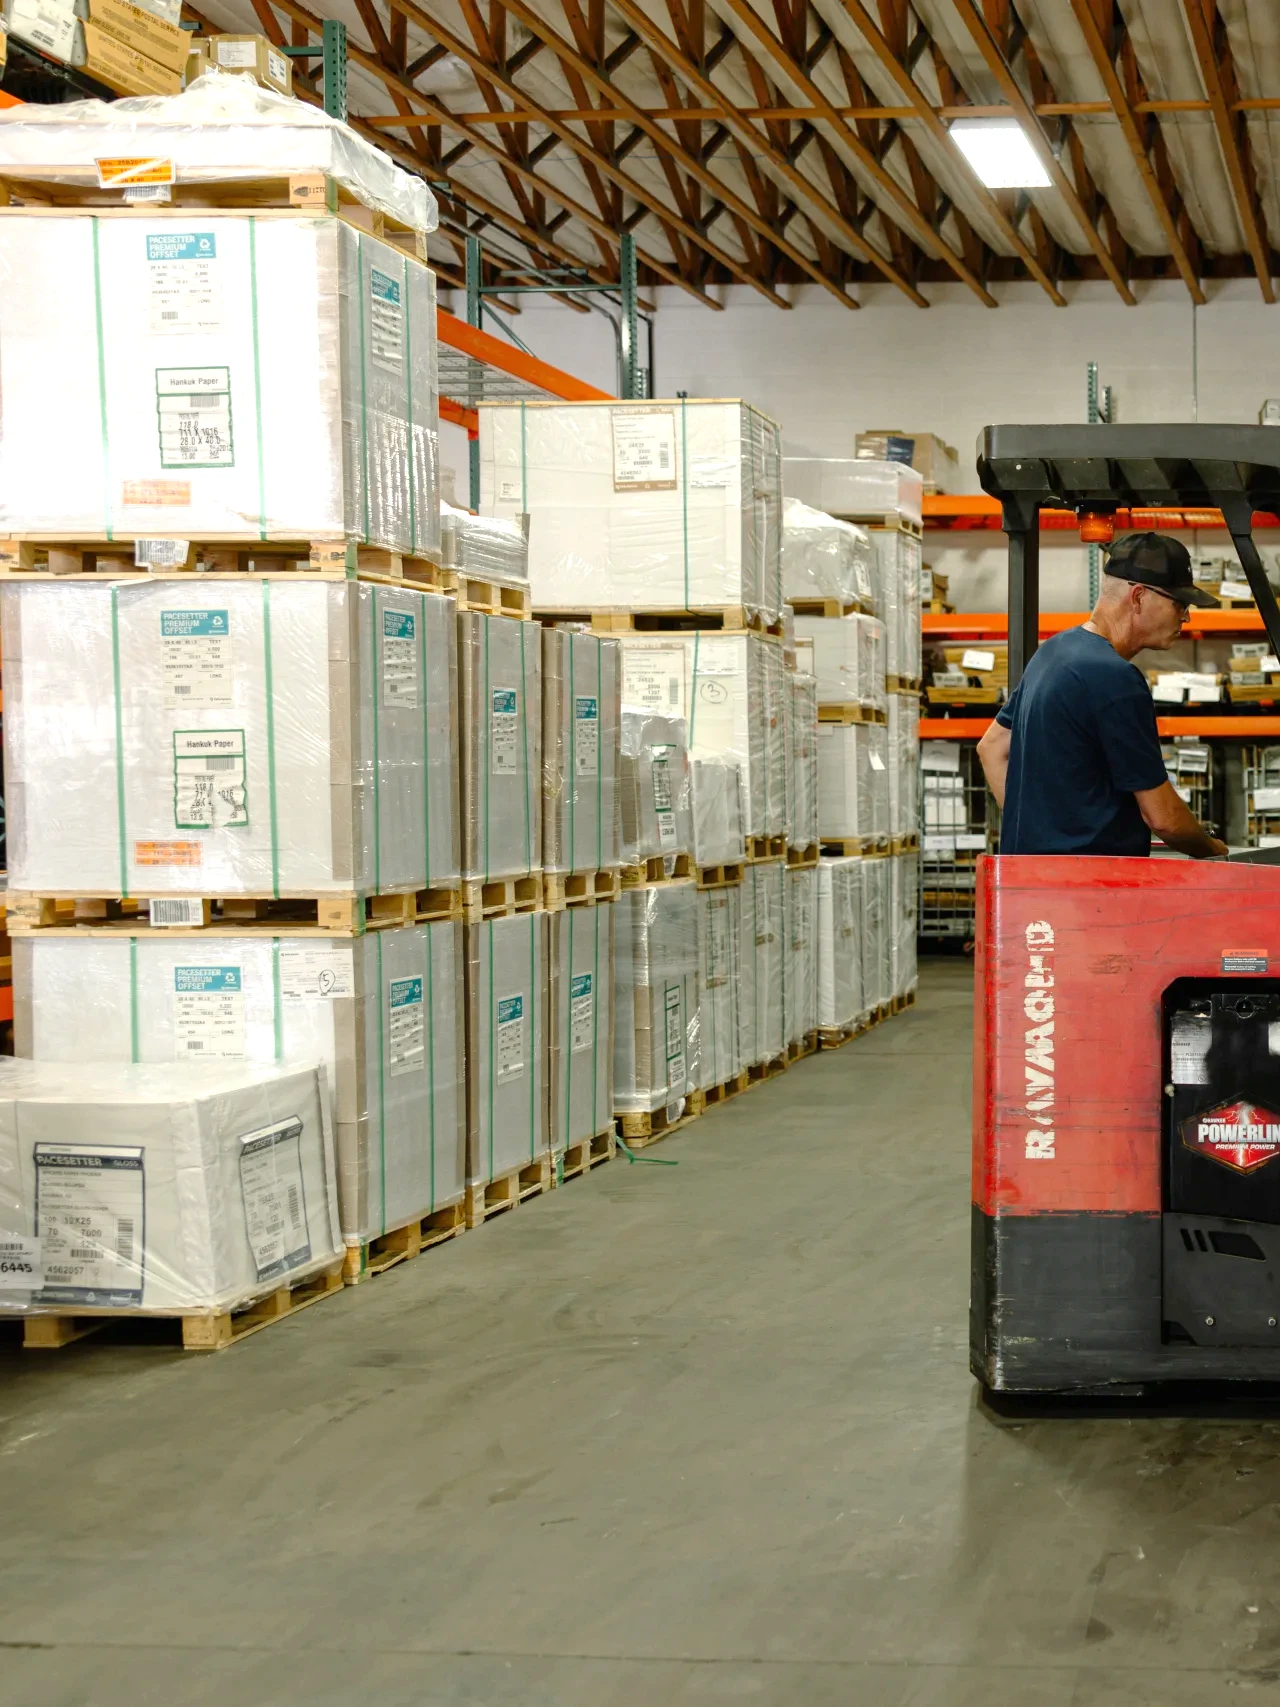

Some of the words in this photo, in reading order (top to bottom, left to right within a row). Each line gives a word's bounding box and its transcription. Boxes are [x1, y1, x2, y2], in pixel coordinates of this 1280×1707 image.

[149, 235, 196, 244] PACESETTER
[149, 243, 187, 251] PREMIUM
[149, 251, 180, 259] OFFSET
[170, 378, 196, 386] Hankuk
[198, 377, 219, 387] Paper
[164, 613, 209, 621] PACESETTER
[164, 620, 201, 628] PREMIUM
[164, 627, 193, 635] OFFSET
[187, 740, 212, 748] Hankuk
[214, 740, 234, 749] Paper
[177, 969, 221, 977] PACESETTER
[177, 976, 213, 984] PREMIUM
[178, 982, 206, 991] OFFSET
[1215, 1143, 1250, 1151] PREMIUM
[1250, 1143, 1276, 1151] POWER
[36, 1154, 103, 1167] PACESETTER
[112, 1159, 139, 1167] GLOSS
[1, 1262, 33, 1273] 6445
